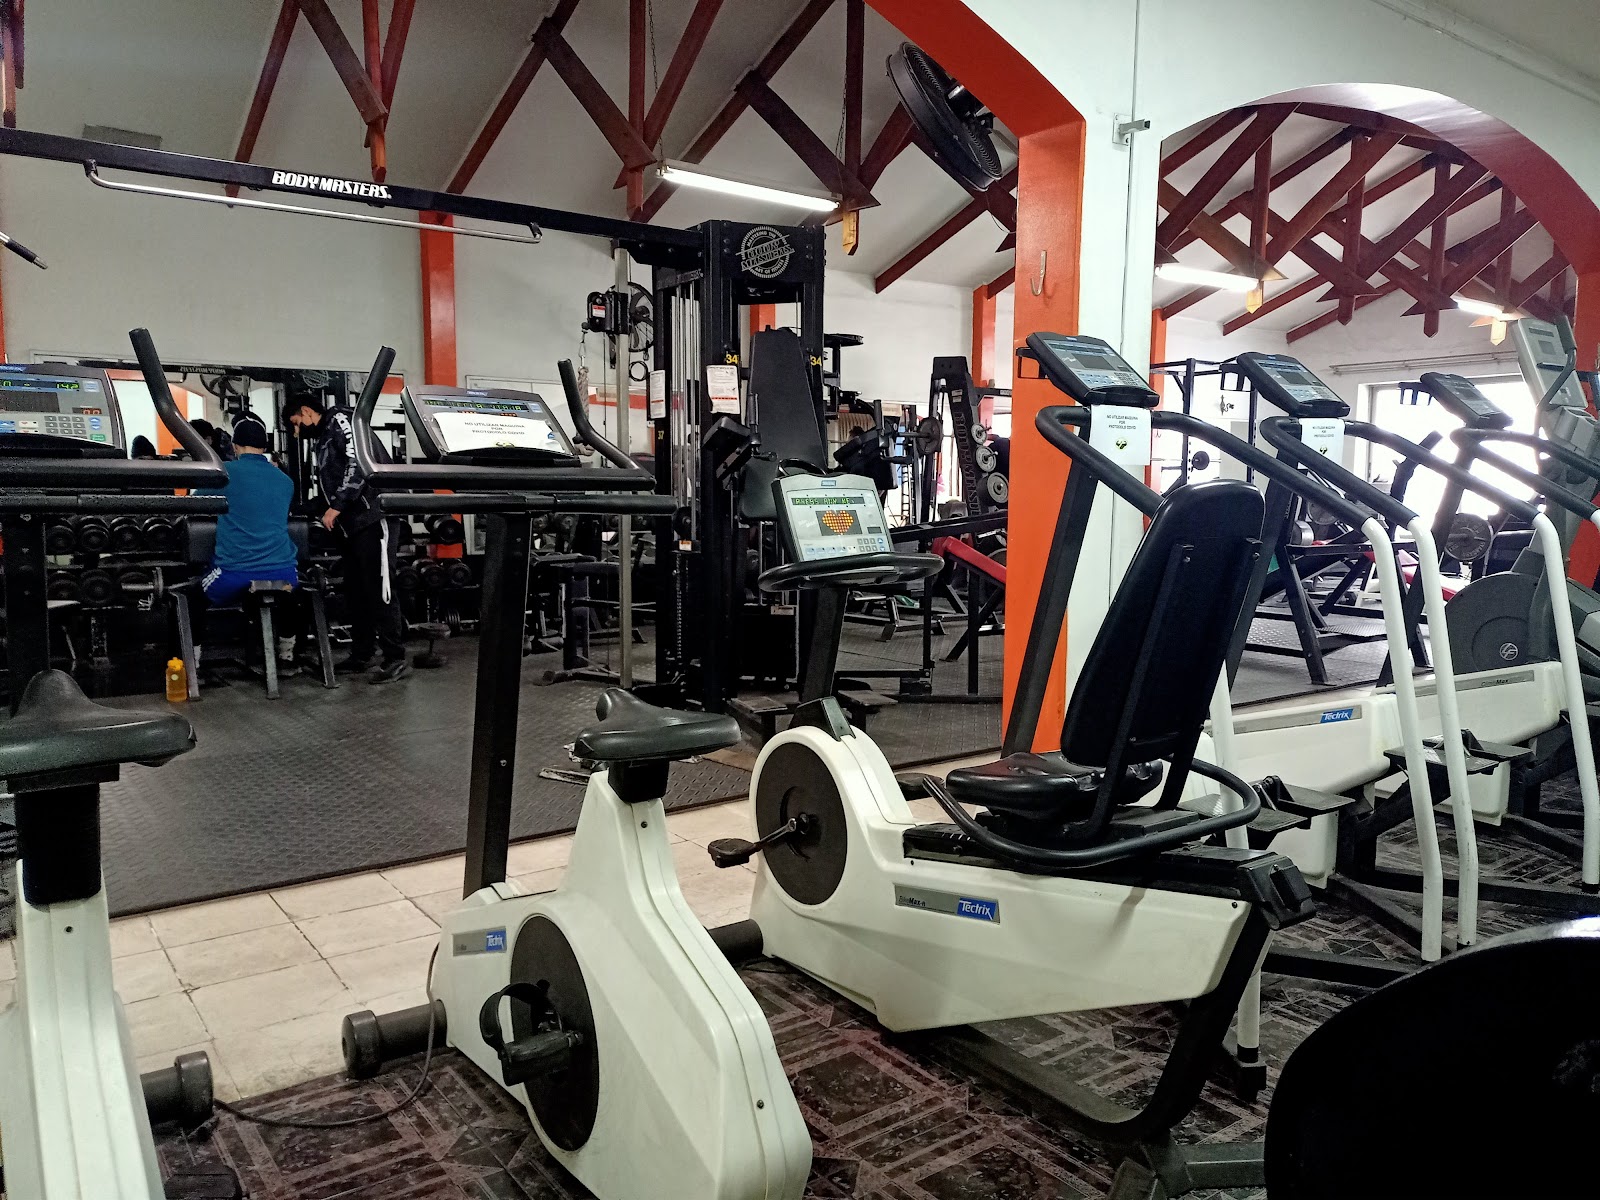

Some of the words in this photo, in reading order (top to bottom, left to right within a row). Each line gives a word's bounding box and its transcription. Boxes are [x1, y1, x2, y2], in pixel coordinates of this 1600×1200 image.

[726, 354, 739, 364] 34
[810, 356, 822, 366] 34
[959, 899, 993, 921] Tectrix
